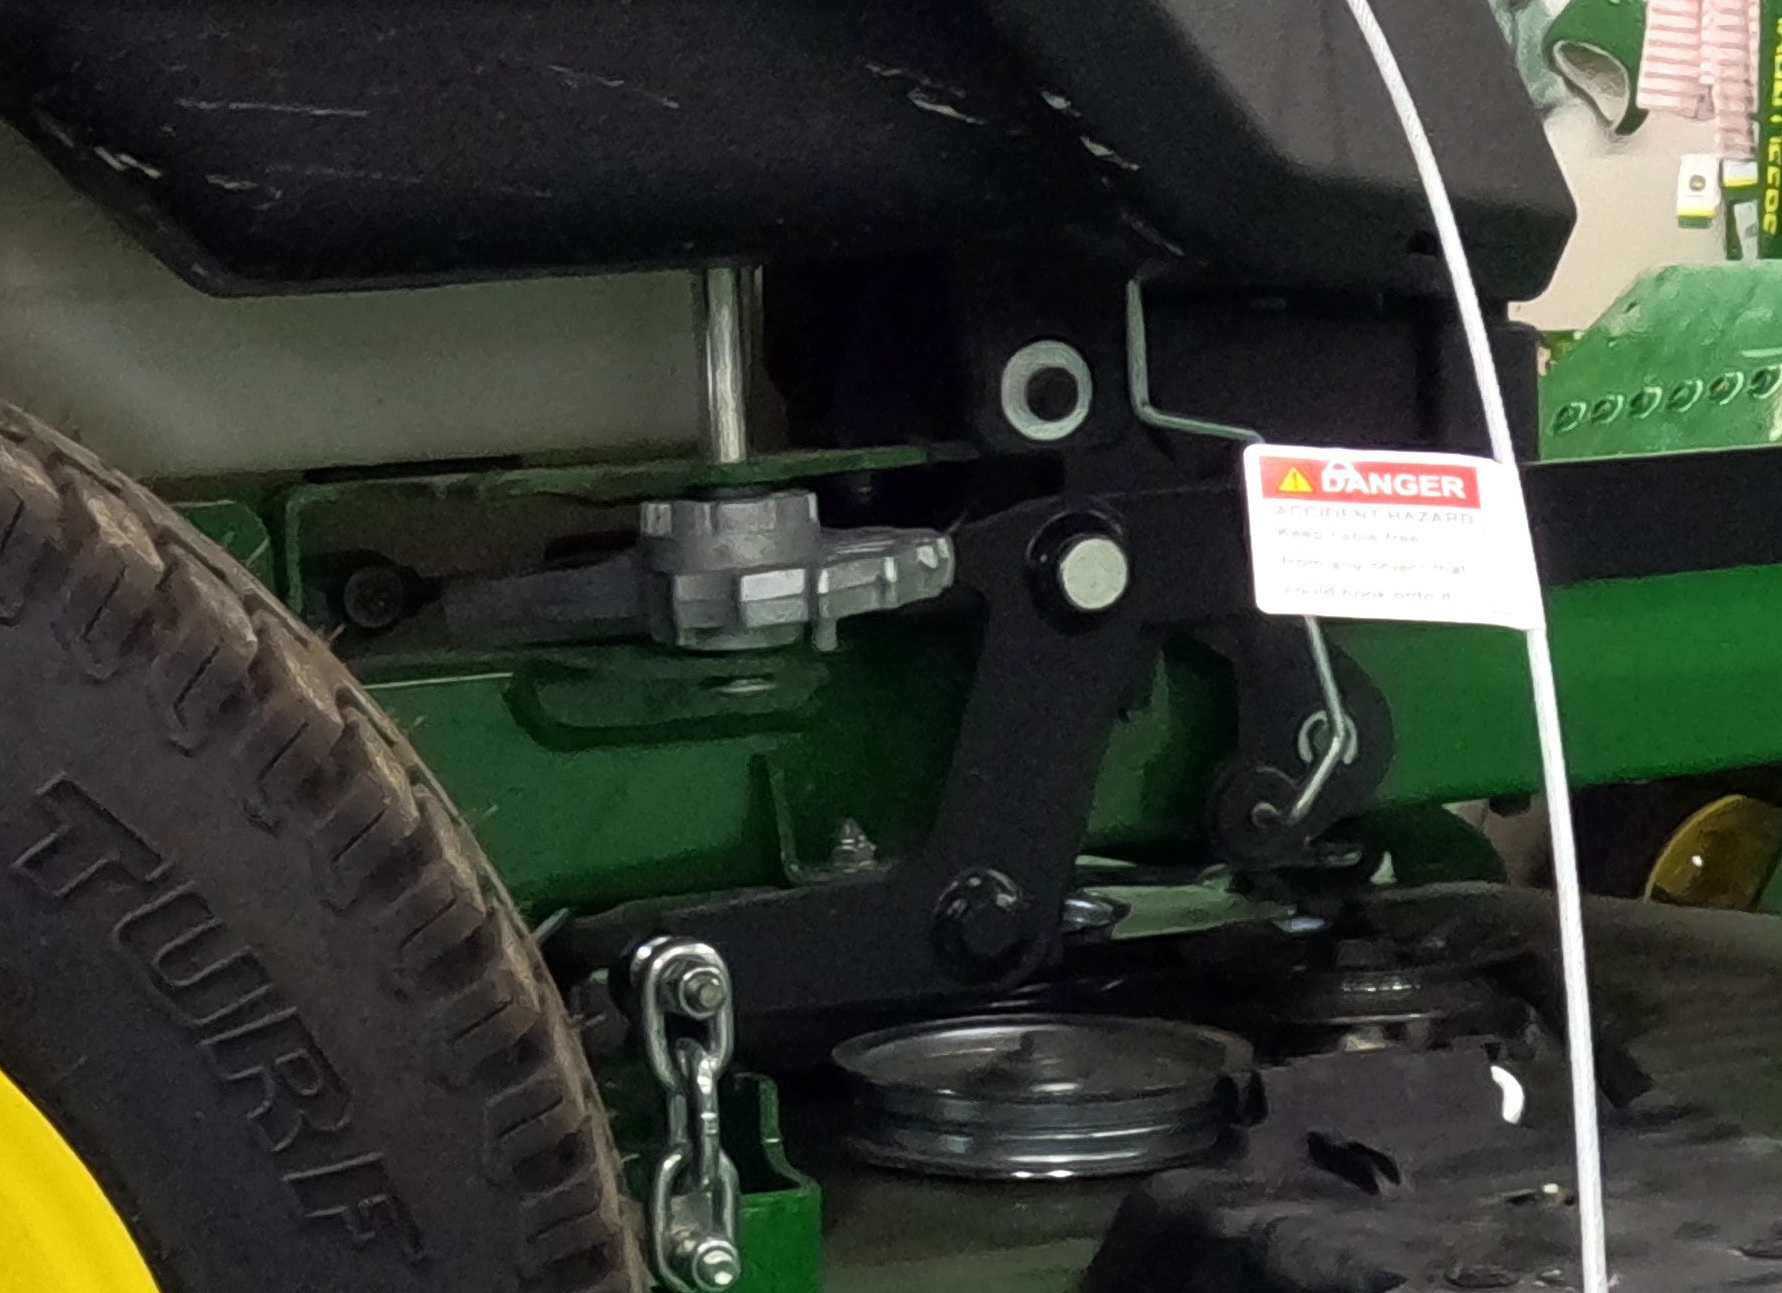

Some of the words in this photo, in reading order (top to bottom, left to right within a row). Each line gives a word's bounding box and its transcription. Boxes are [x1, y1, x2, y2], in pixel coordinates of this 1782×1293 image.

[1321, 472, 1467, 499] DANGER
[1387, 510, 1475, 526] HAZARD
[12, 770, 425, 1262] TURF
